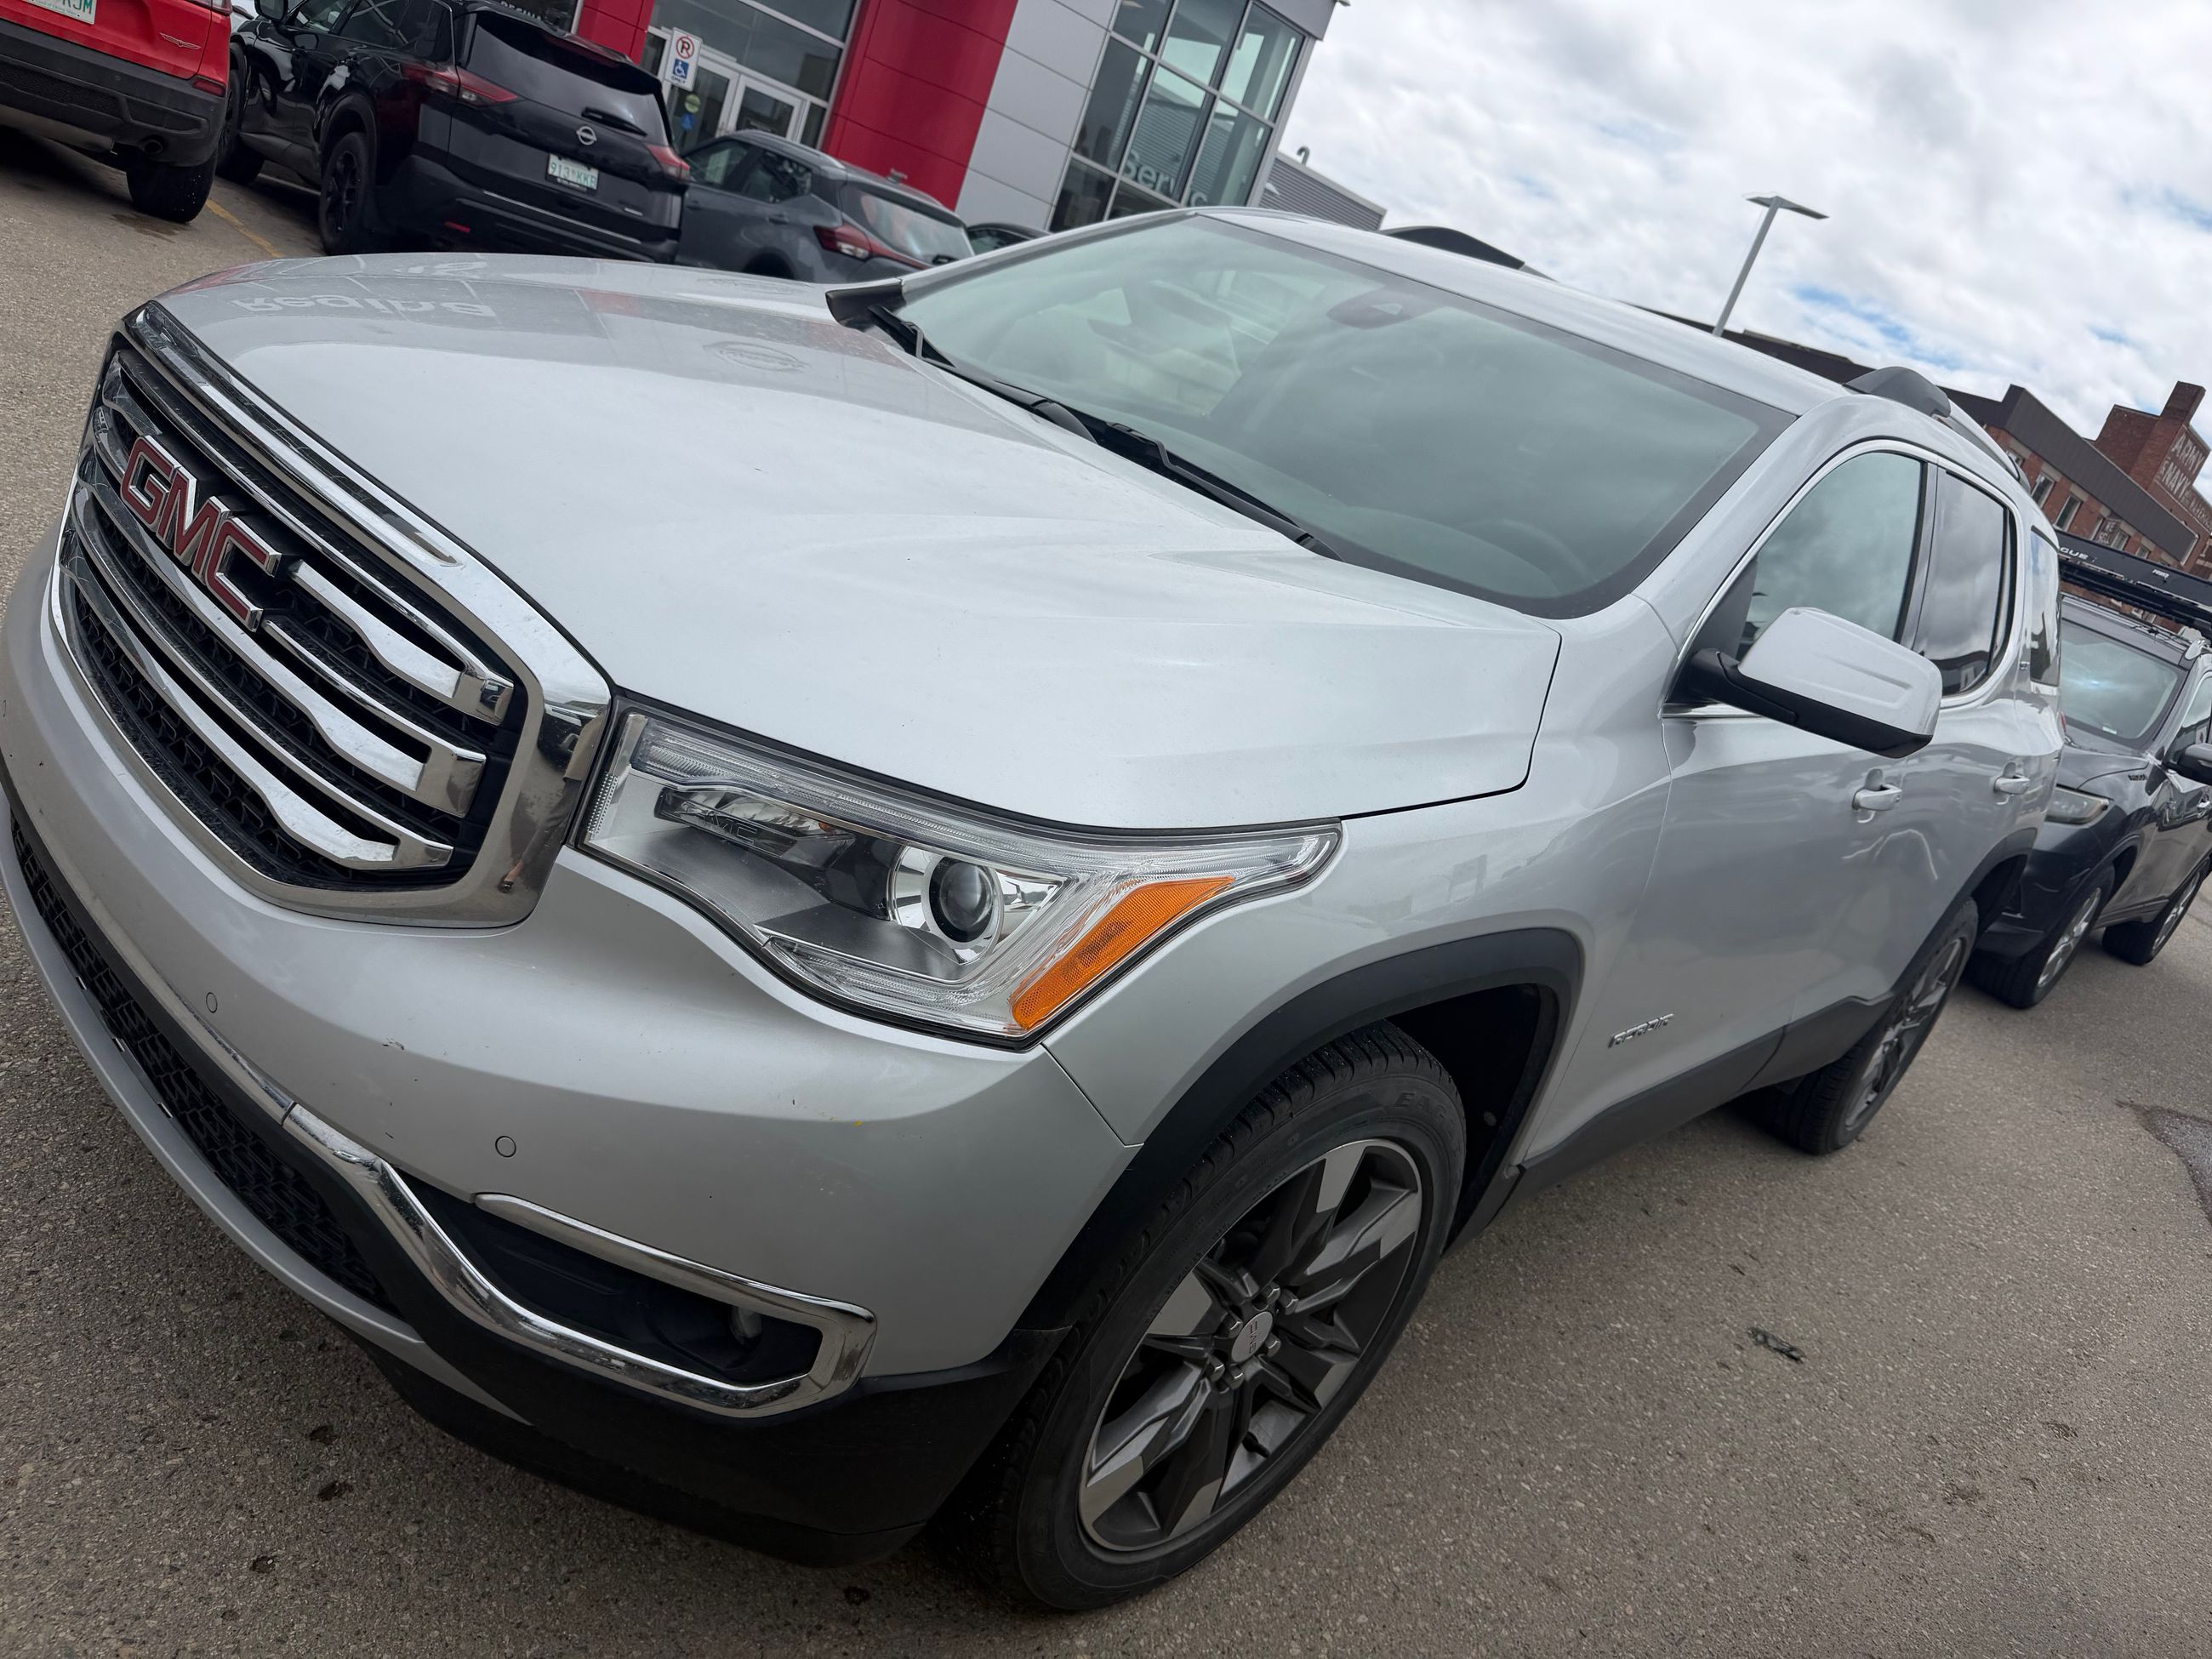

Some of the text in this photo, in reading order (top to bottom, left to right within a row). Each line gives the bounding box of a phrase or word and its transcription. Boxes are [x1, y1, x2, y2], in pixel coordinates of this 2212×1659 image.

[2170, 431, 2206, 475] ARMY
[2161, 461, 2192, 499] NAVY
[121, 435, 282, 632] GMC
[1248, 1319, 1258, 1354] GMC
